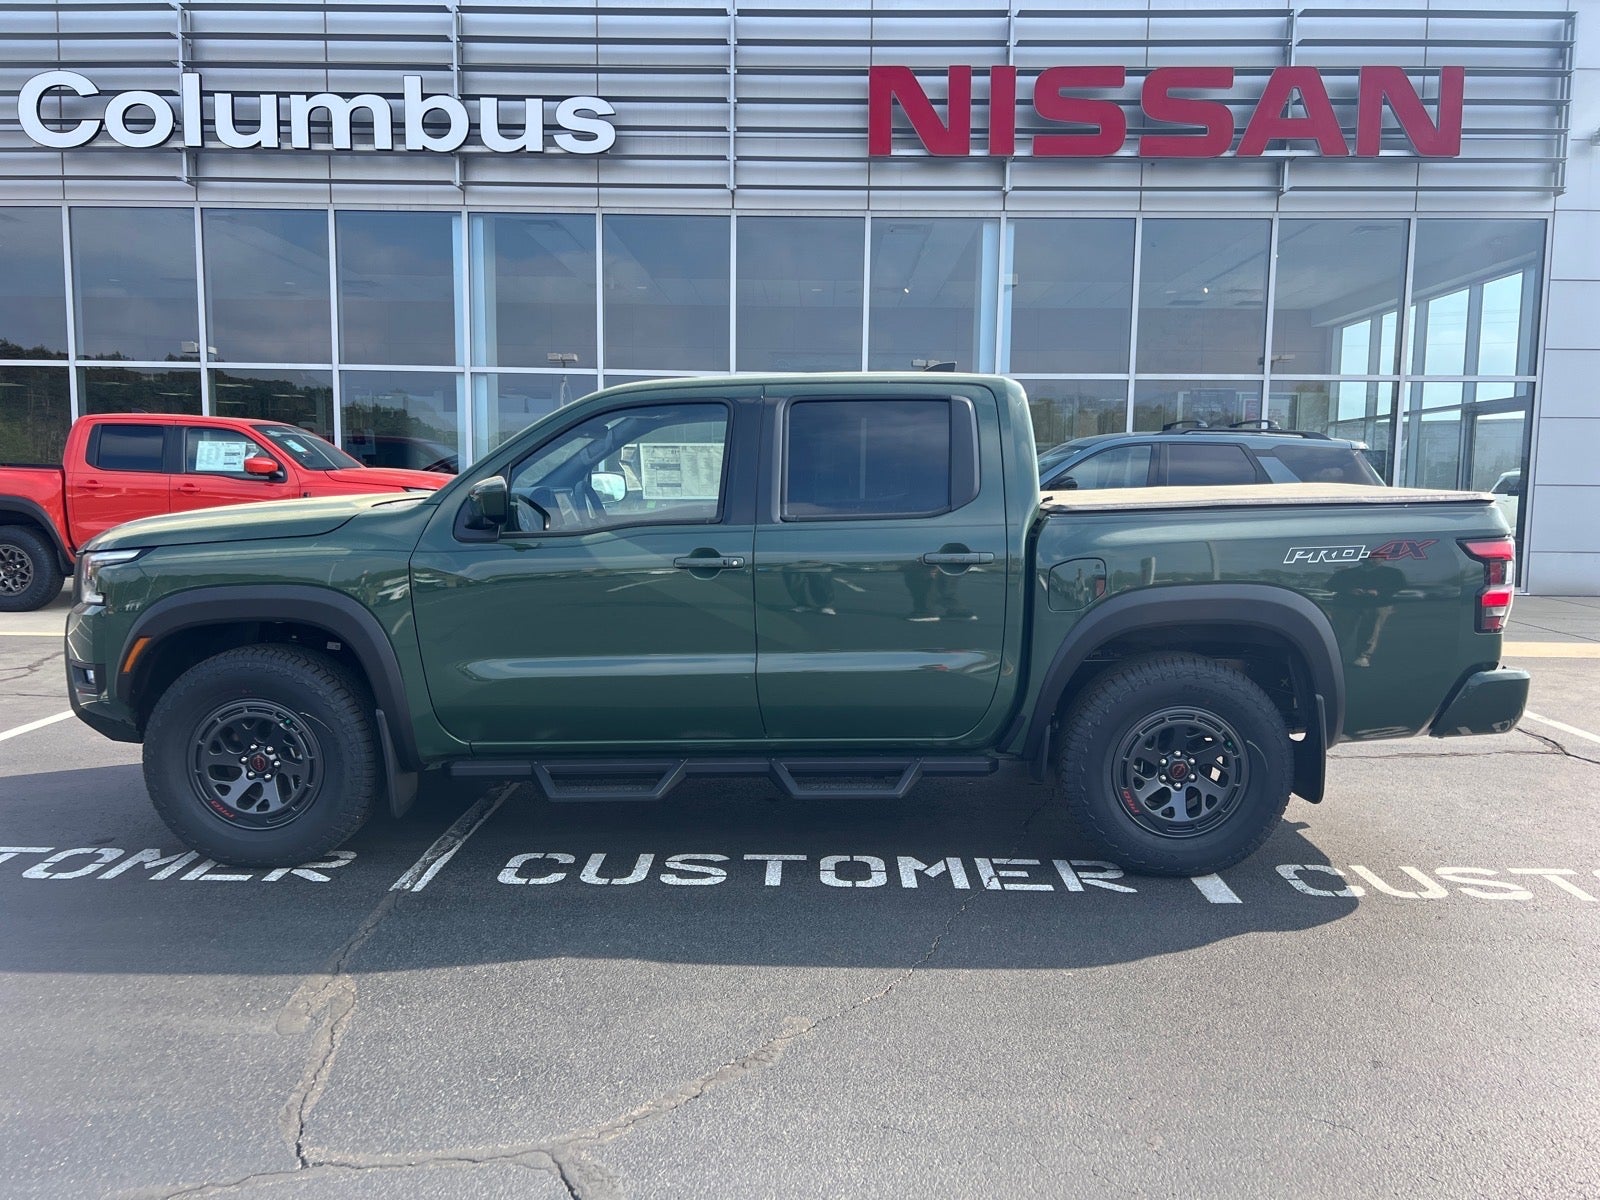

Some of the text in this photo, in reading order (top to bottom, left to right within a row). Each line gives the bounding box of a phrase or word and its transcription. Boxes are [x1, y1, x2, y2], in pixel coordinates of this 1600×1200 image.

[17, 70, 616, 155] Columbus
[868, 65, 1465, 158] NISSAN
[497, 853, 1138, 893] CUSTOMER
[1275, 864, 1600, 902] CUST
